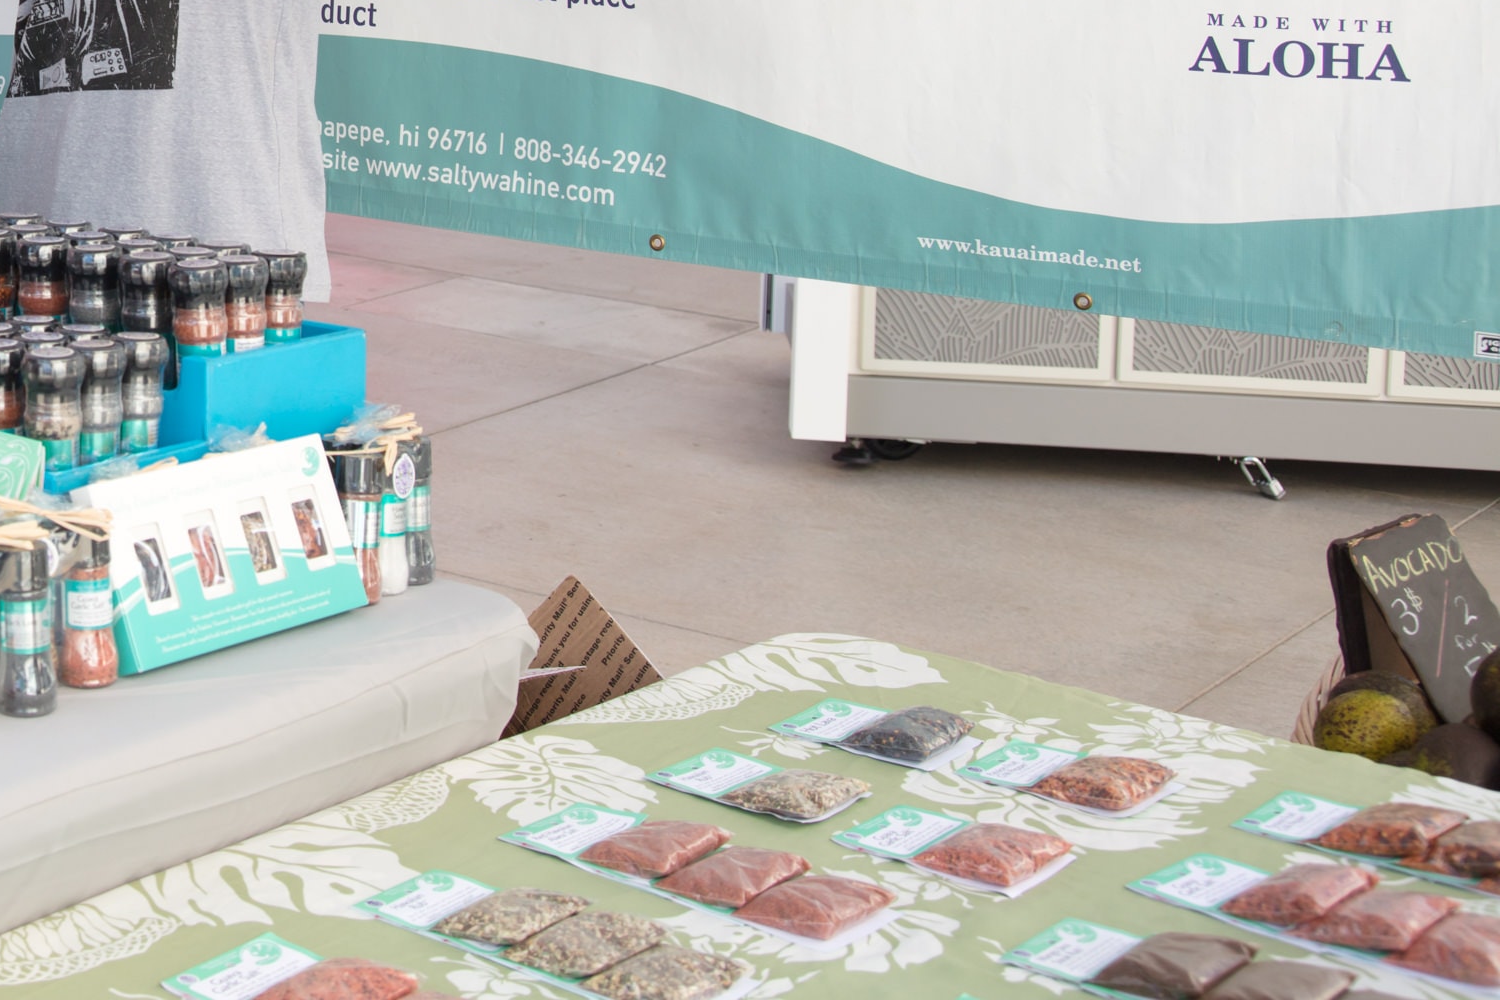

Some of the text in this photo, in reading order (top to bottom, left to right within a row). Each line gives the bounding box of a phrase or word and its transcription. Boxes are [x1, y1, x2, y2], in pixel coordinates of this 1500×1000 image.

[1206, 12, 1394, 34] MADE WITH
[1188, 35, 1412, 83] ALOHA
[399, 124, 419, 147] hi
[427, 127, 487, 155] 96716
[513, 137, 668, 178] 808-346-2942
[366, 156, 615, 206] www.saltywahine.com
[916, 236, 1142, 273] www.kauaimade.net
[1362, 537, 1462, 594] AVOCADO
[1454, 595, 1478, 625] 2
[559, 632, 571, 648] you
[568, 616, 579, 630] for
[601, 633, 626, 666] Priority
[1454, 633, 1478, 650] for
